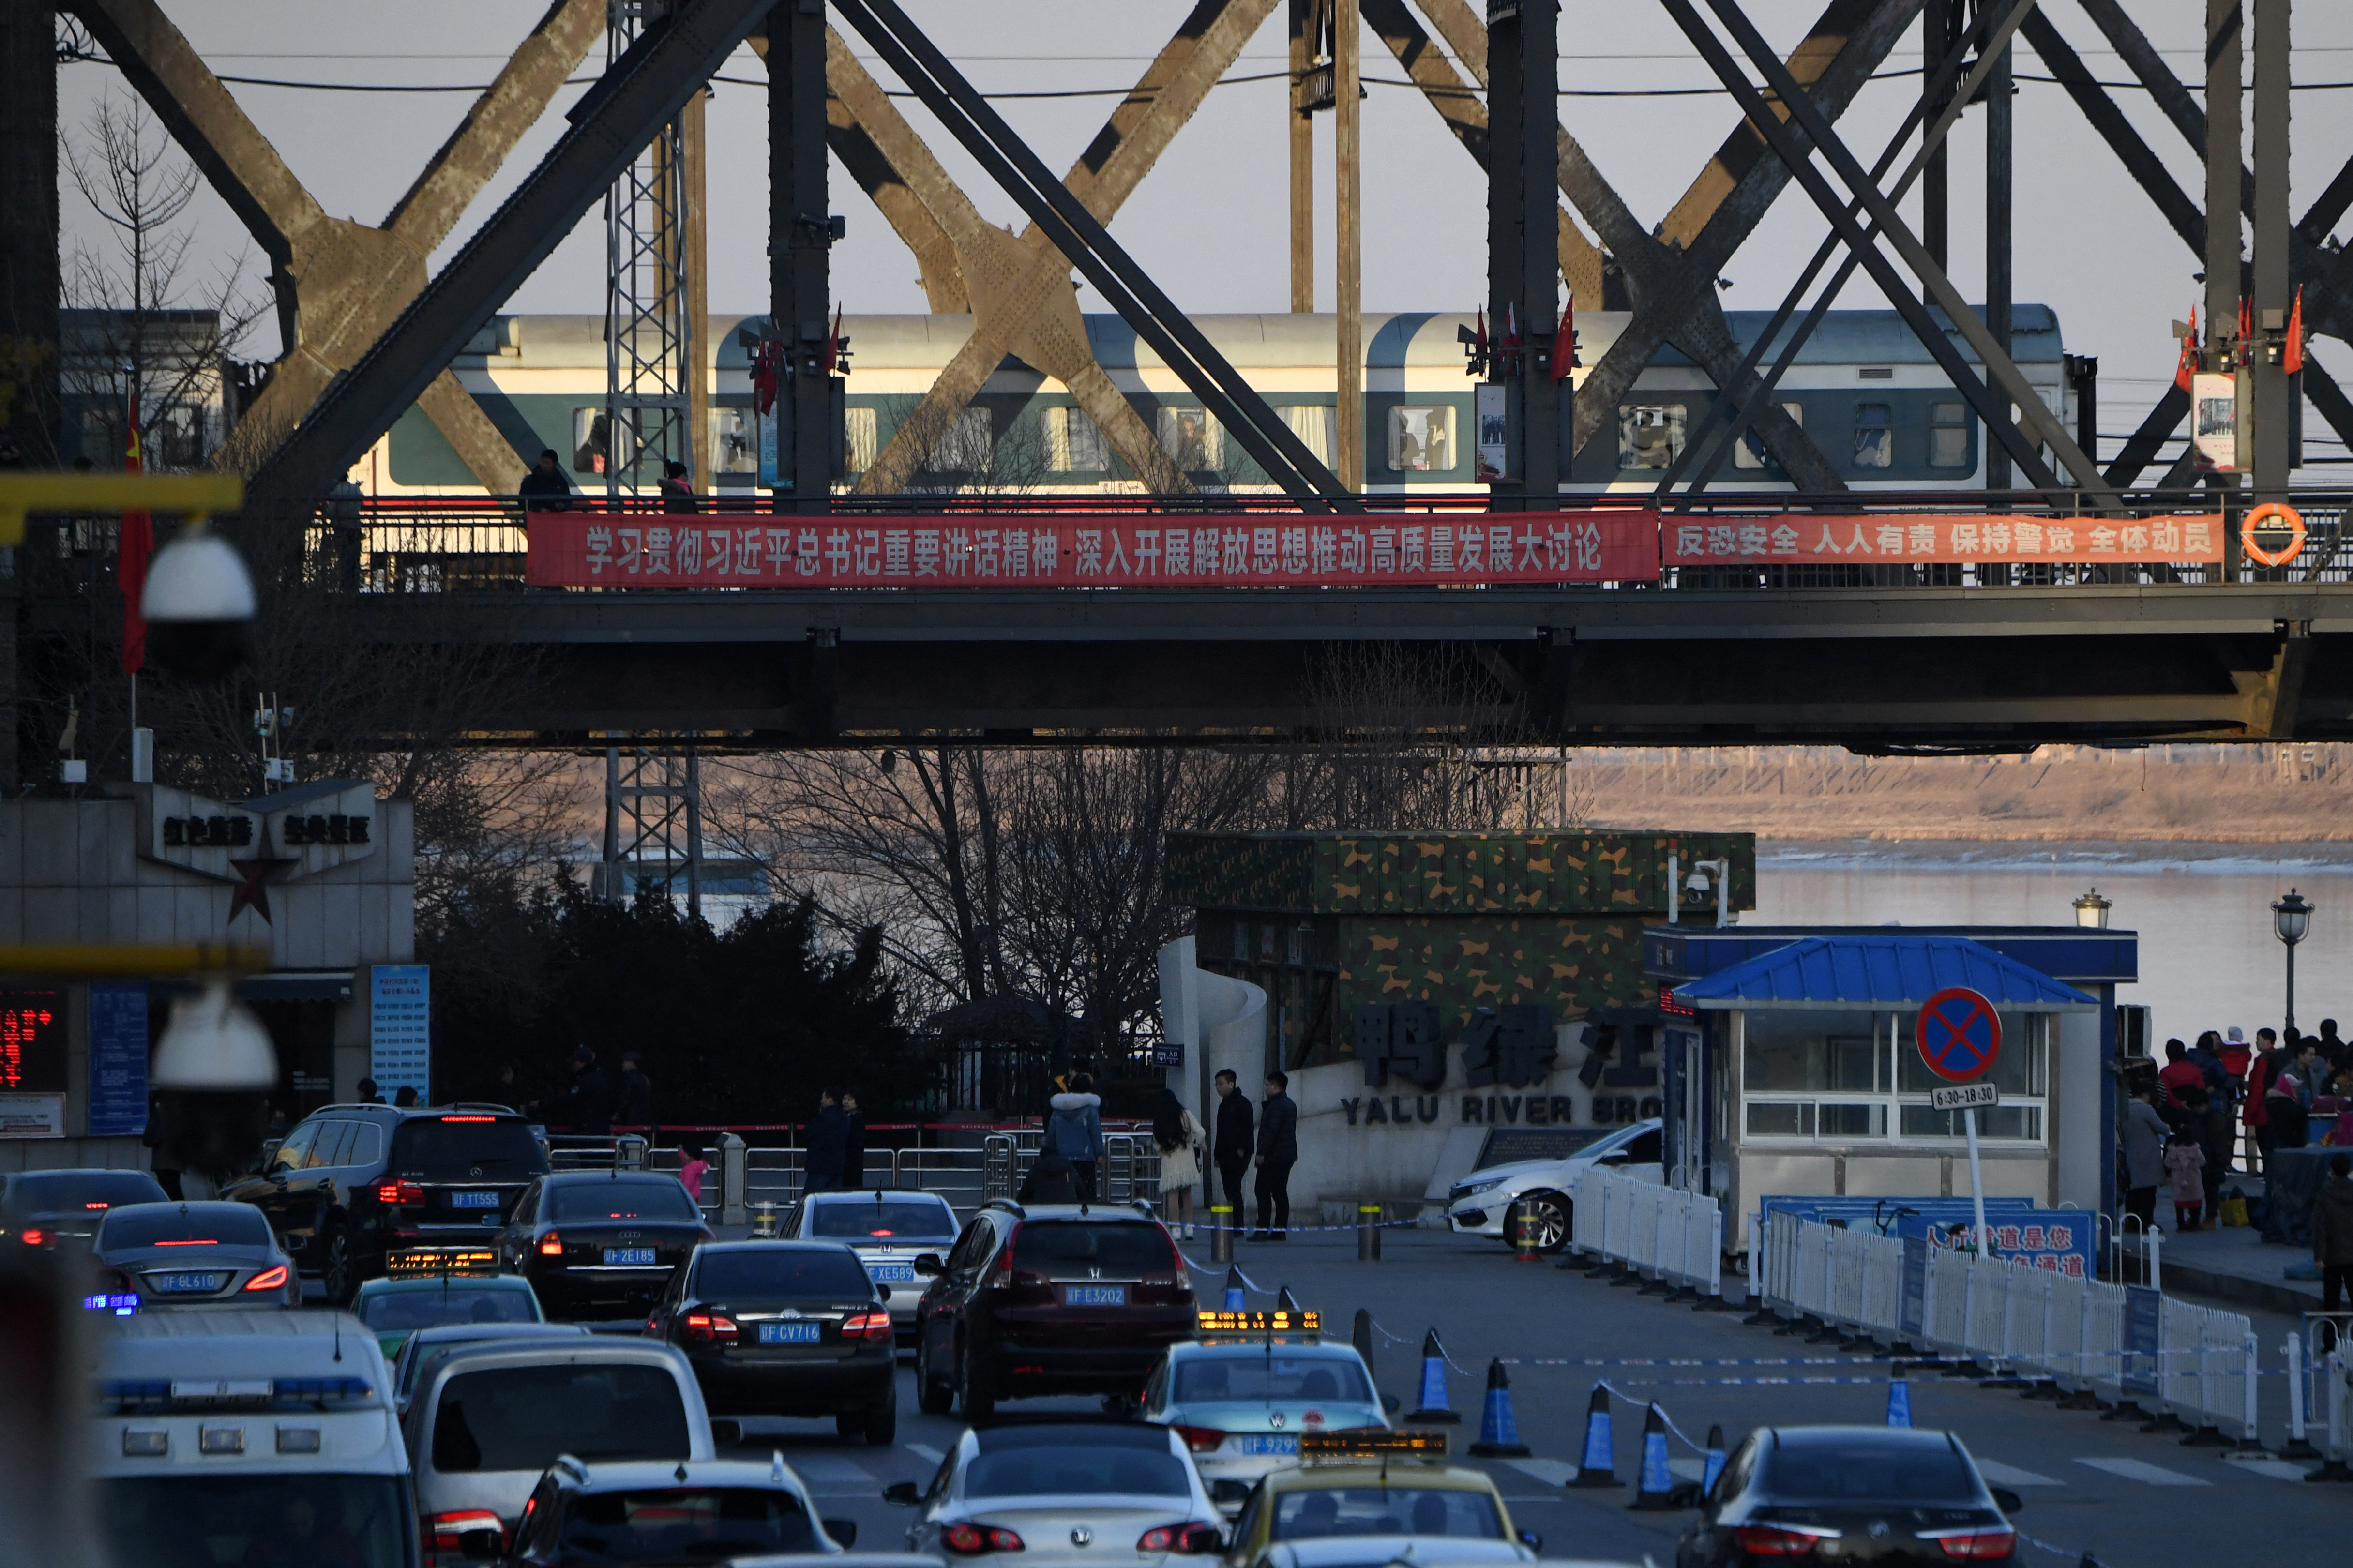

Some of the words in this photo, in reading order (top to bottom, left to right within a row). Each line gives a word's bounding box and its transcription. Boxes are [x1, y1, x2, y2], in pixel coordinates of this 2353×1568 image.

[586, 525, 1058, 577] 学习贯彻习近平总书记重要讲话精神
[1075, 522, 1602, 577] 深入开展解放思想推动高质量发展大讨论
[1676, 524, 1799, 556] 反恐安全
[1814, 524, 1937, 556] 人人有责
[1951, 521, 2075, 555] 保持警觉
[2089, 520, 2213, 554] 全体动员
[1353, 1000, 1661, 1090] 鸭绿江
[1341, 1096, 1439, 1125] YALU
[1462, 1095, 1572, 1123] RIVER
[1937, 1086, 1993, 1106] 6:30-18:30
